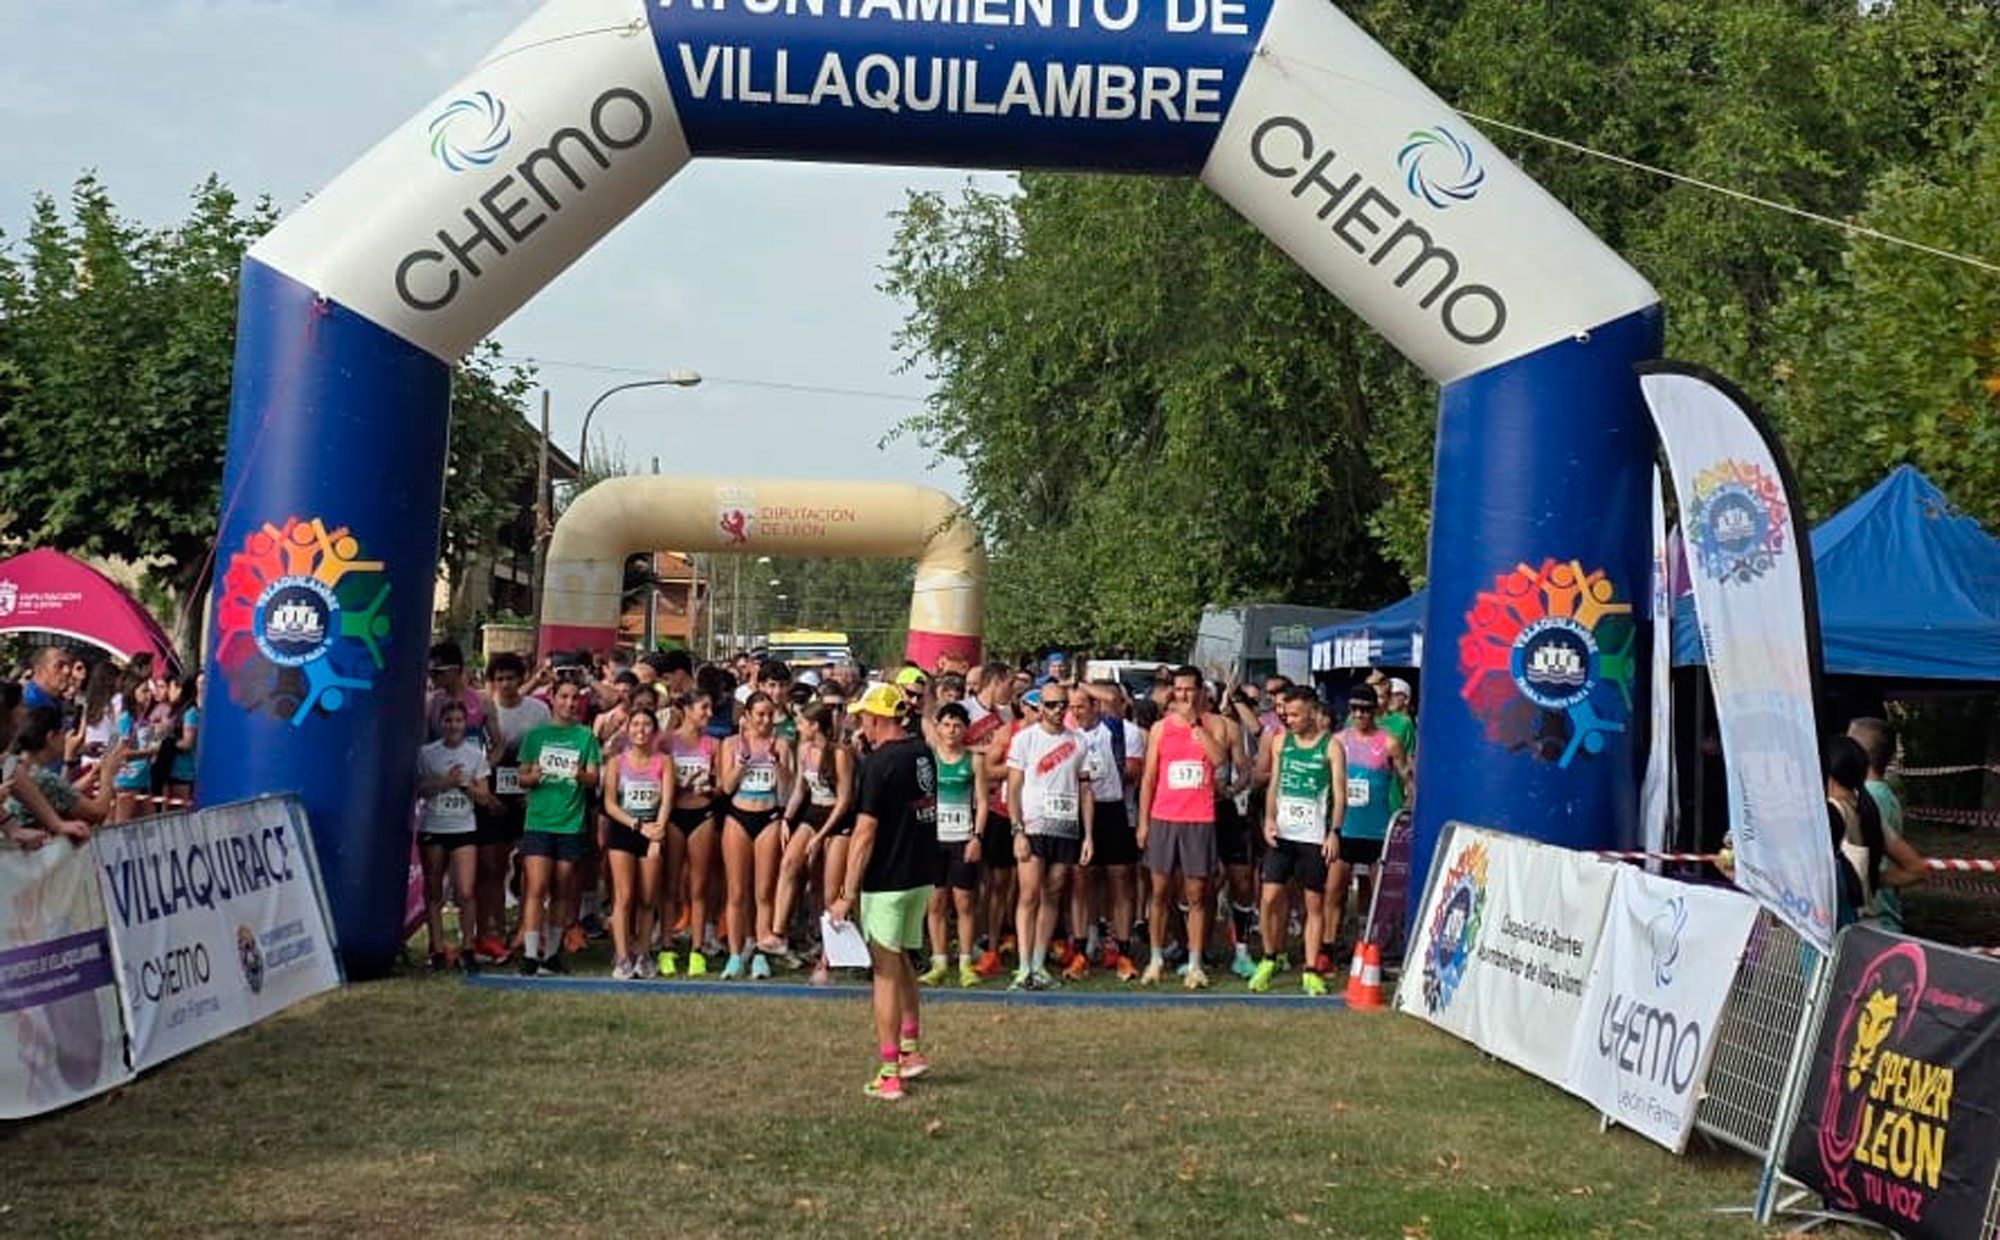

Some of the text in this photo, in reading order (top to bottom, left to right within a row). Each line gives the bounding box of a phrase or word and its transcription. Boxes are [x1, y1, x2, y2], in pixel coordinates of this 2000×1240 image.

[678, 42, 1223, 123] VILLAQUILAMBRE
[105, 826, 294, 928] VILLAQUIRACE
[141, 942, 211, 1003] CHEMO
[1862, 1172, 1924, 1223] TU VOZ
